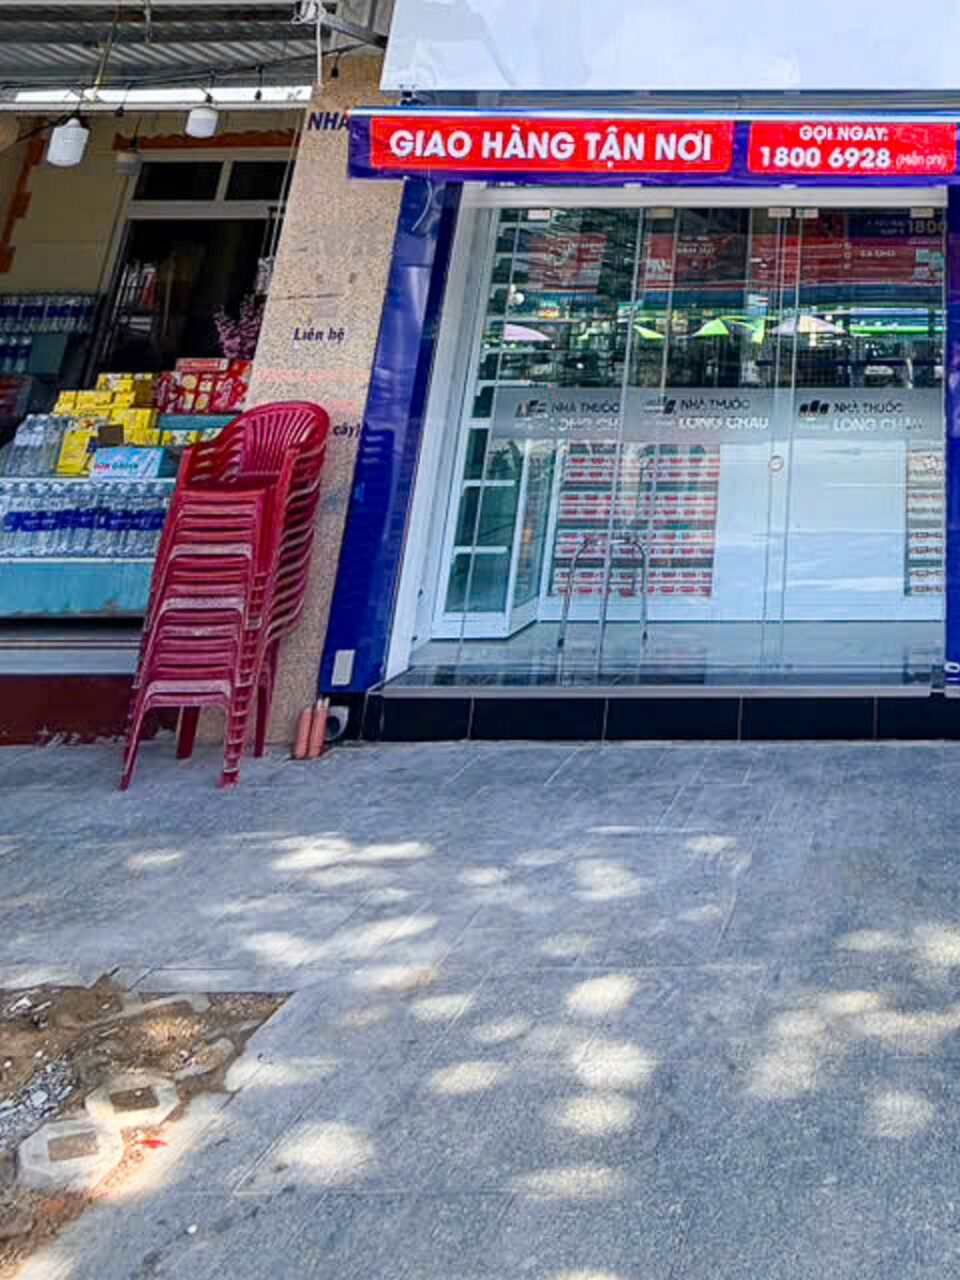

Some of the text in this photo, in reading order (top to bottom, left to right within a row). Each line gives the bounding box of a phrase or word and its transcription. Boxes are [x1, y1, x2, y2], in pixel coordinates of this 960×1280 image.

[799, 125, 888, 144] GỌI NGAY:
[389, 125, 711, 168] GIAO HÀNG TẬN NƠI
[760, 147, 821, 168] 1800
[828, 147, 890, 168] 6928
[679, 417, 721, 430] LONG
